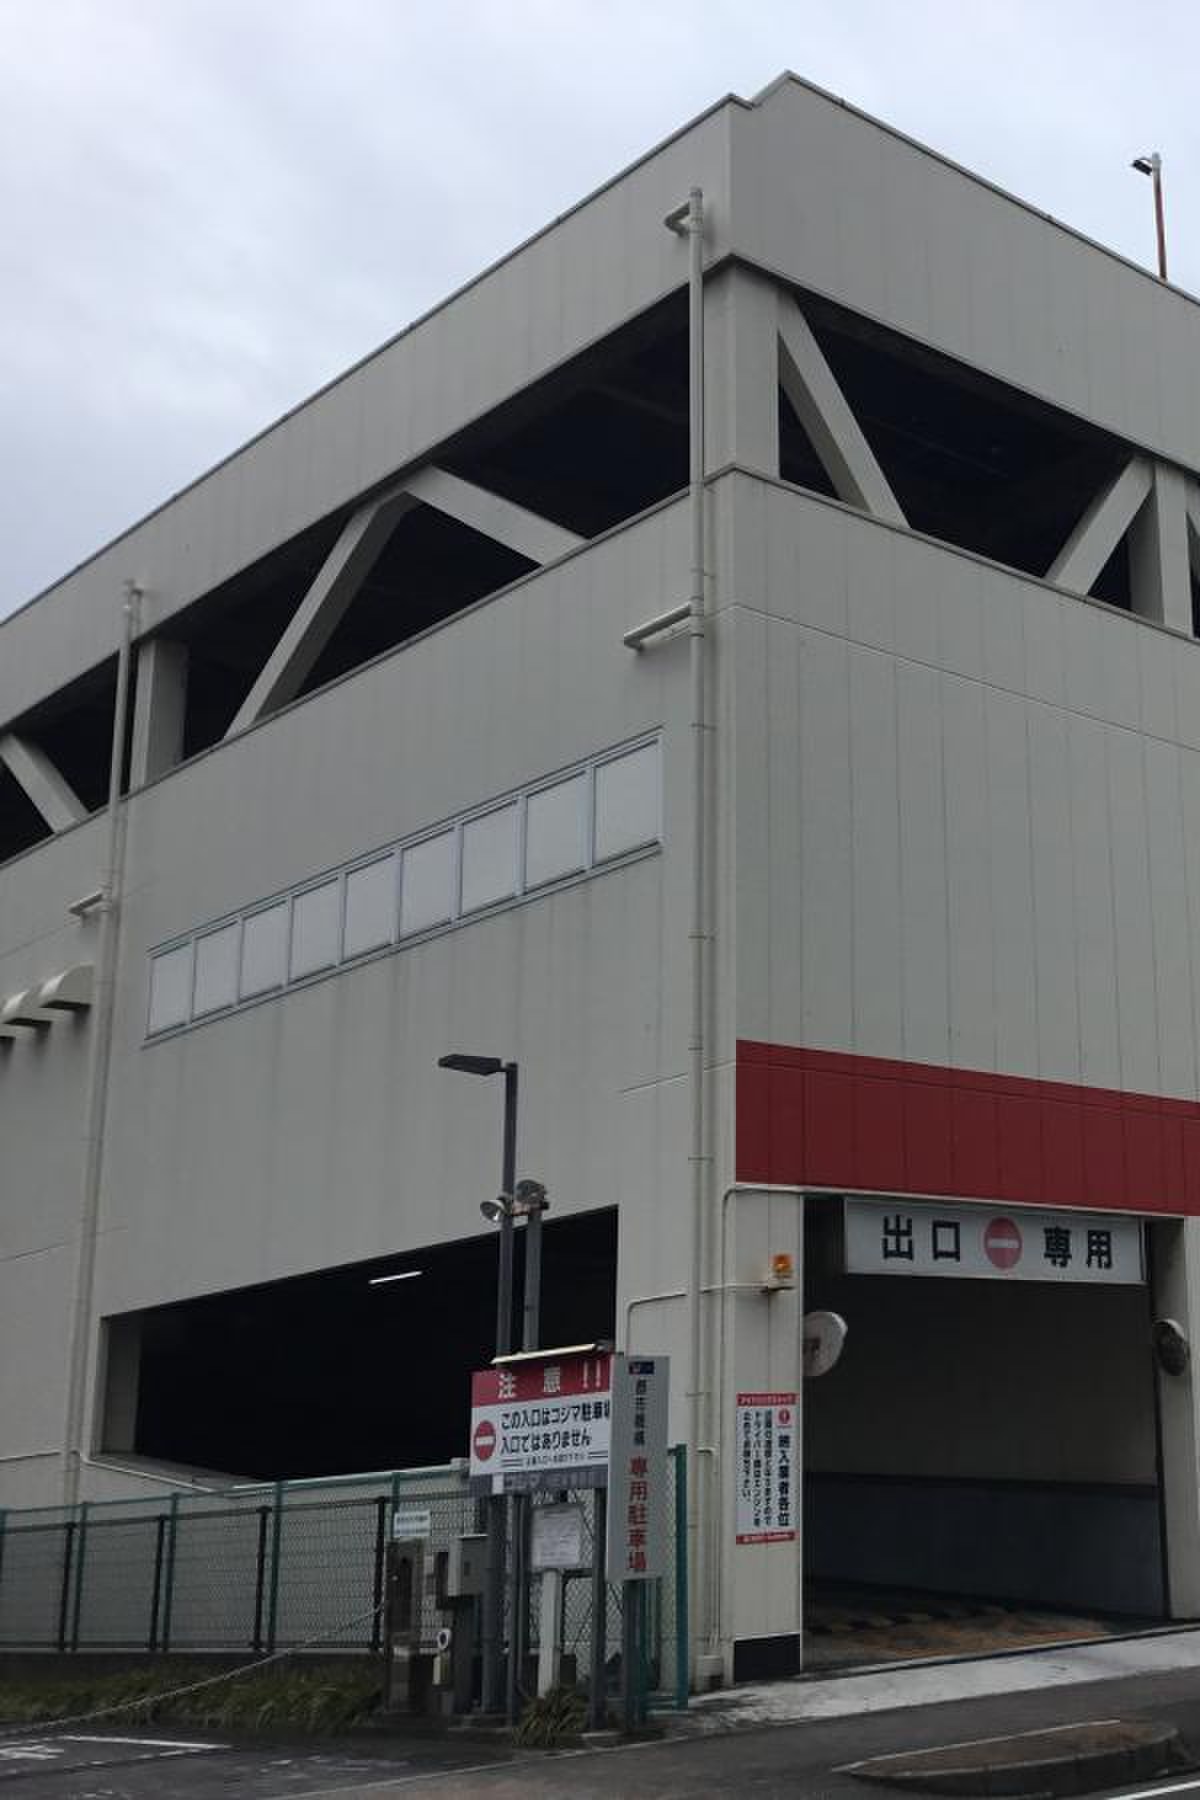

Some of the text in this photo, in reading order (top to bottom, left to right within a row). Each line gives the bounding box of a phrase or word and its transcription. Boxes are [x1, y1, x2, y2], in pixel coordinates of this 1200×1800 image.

[882, 1214, 1113, 1269] 出口 専用
[501, 1427, 591, 1455] 入口ではありません
[627, 1456, 648, 1574] 専用駐車場
